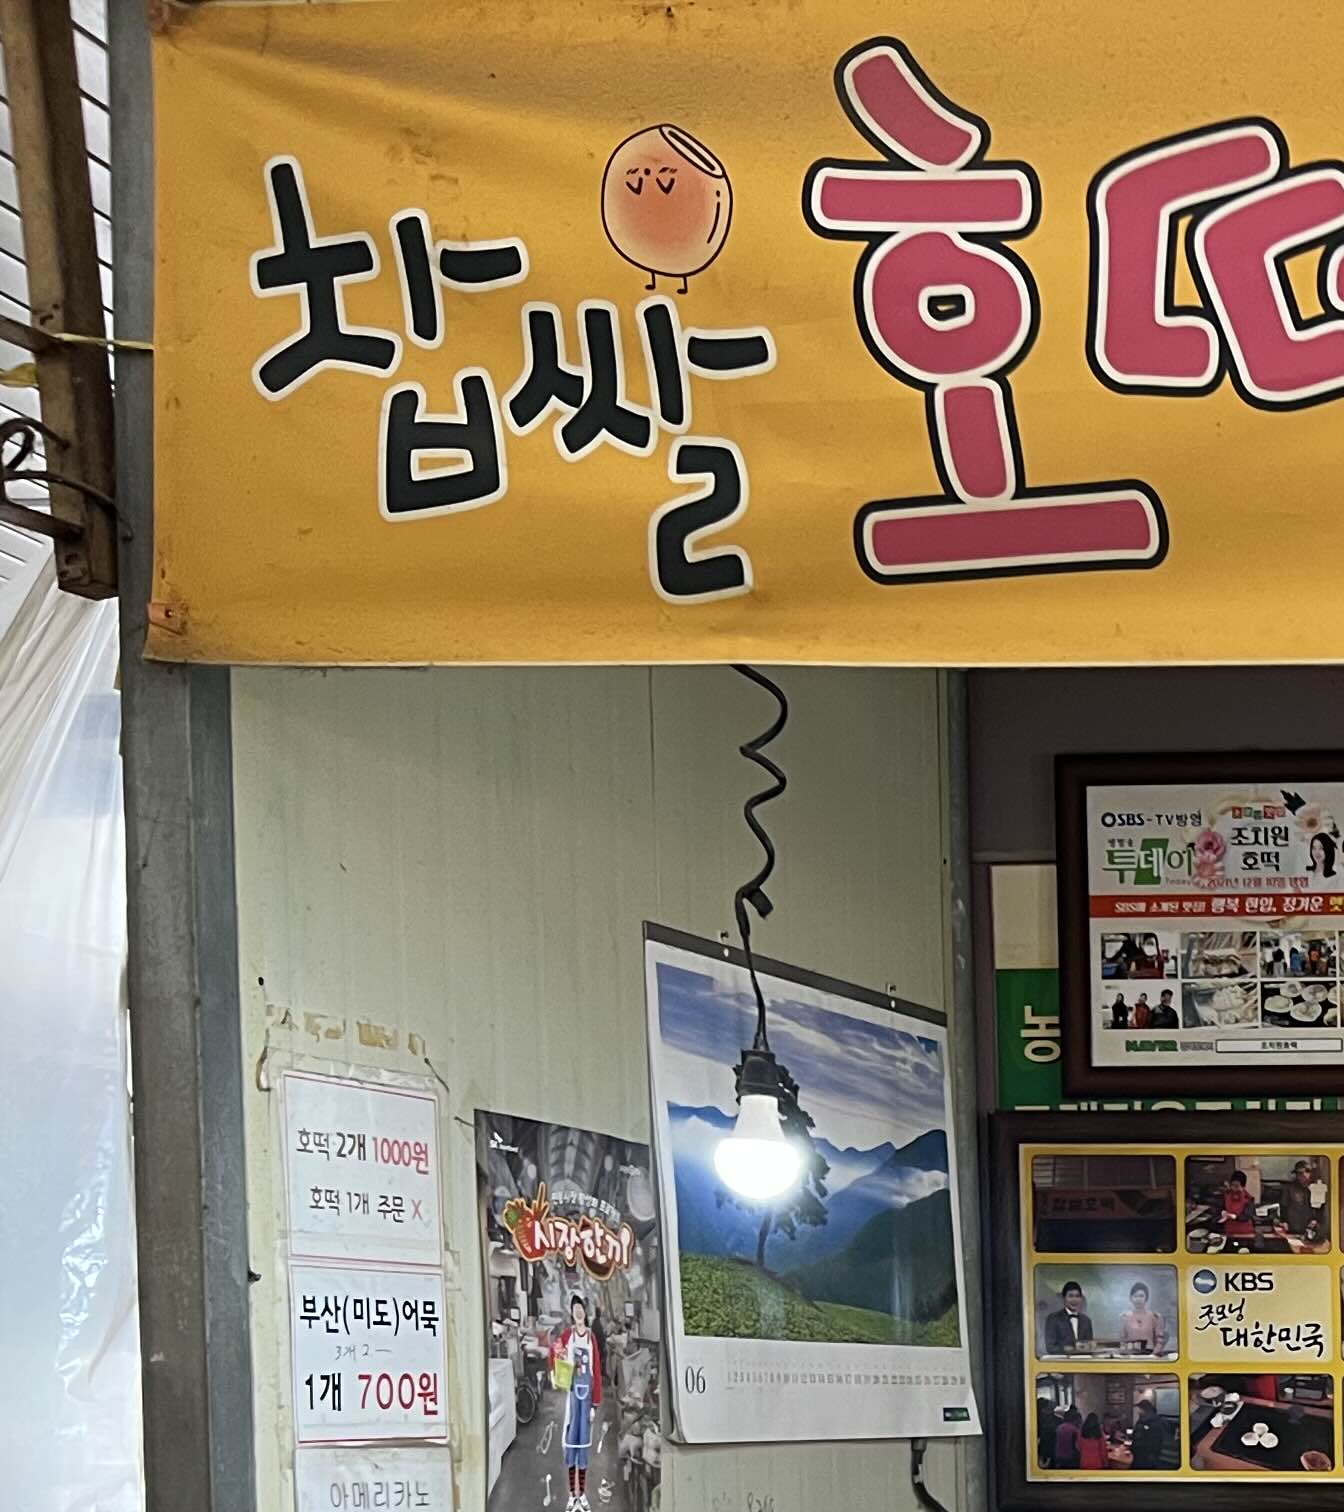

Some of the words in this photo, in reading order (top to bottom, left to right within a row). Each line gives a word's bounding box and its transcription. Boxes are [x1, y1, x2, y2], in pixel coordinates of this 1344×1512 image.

[249, 155, 776, 602] 찹쌀
[1230, 826, 1289, 846] 조치원
[1102, 847, 1192, 884] 투데이
[1241, 851, 1280, 871] 호떡
[296, 1128, 330, 1156] 호떡
[336, 1131, 366, 1161] 2개
[373, 1138, 429, 1175] 1000원
[310, 1187, 339, 1213] 호떡
[347, 1191, 369, 1217] 1개
[378, 1194, 405, 1223] 주문
[534, 1221, 631, 1265] 시장한끼
[1224, 1273, 1274, 1292] KBS
[300, 1295, 439, 1337] 부산(미도)어묵
[1222, 1323, 1324, 1357] 대한민국
[305, 1372, 343, 1413] 1개
[358, 1372, 439, 1417] 700원
[685, 1366, 706, 1394] 06
[330, 1480, 430, 1509] 아메리카노
